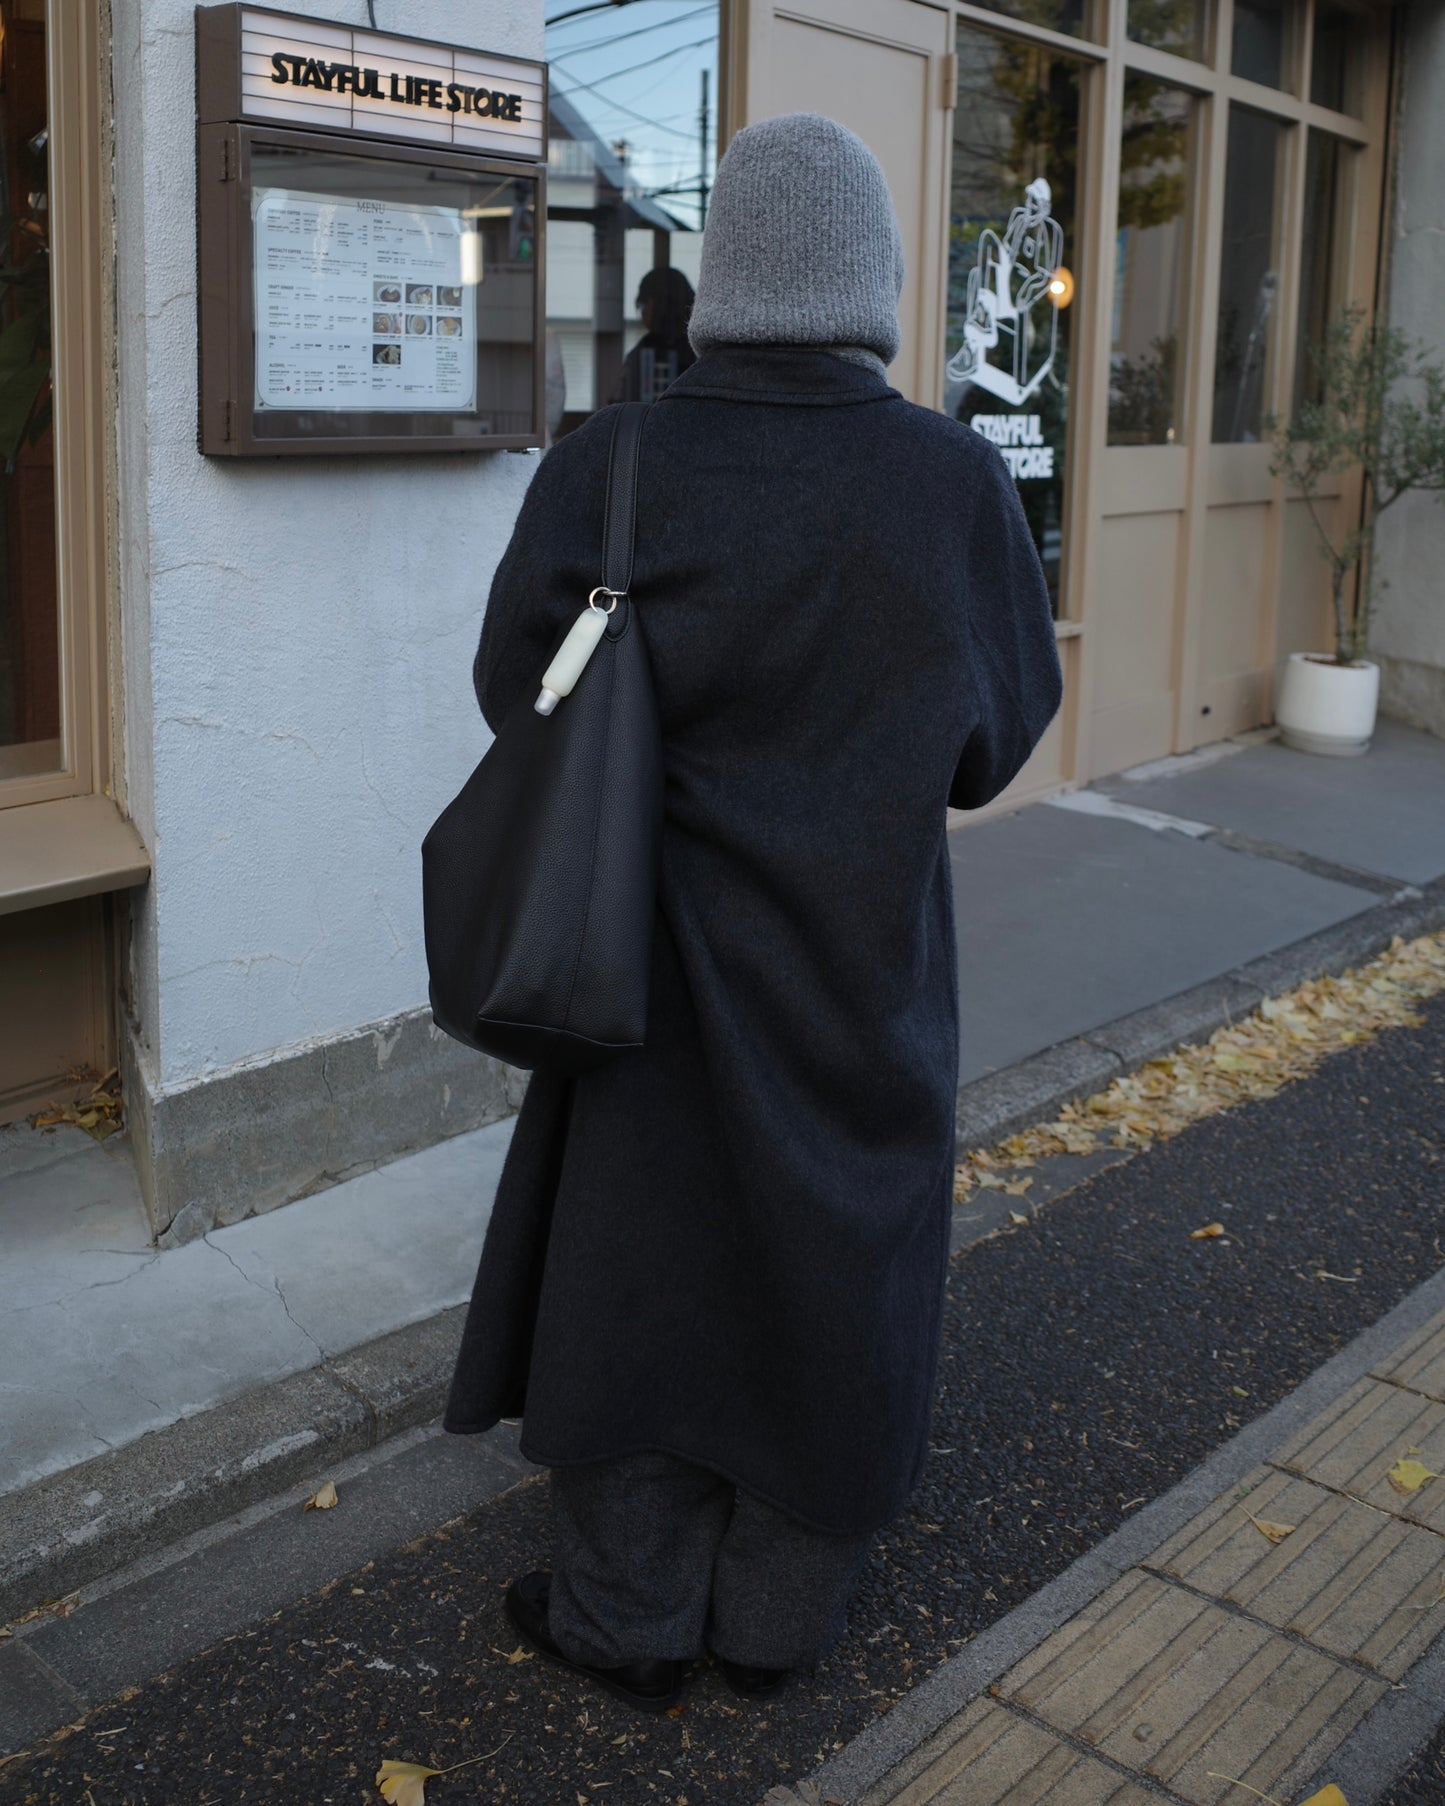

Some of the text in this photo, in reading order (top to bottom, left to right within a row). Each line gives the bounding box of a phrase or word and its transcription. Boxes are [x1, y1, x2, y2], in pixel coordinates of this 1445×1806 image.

[271, 52, 522, 122] STAYFUL LIFE STORE
[357, 201, 386, 215] MENU
